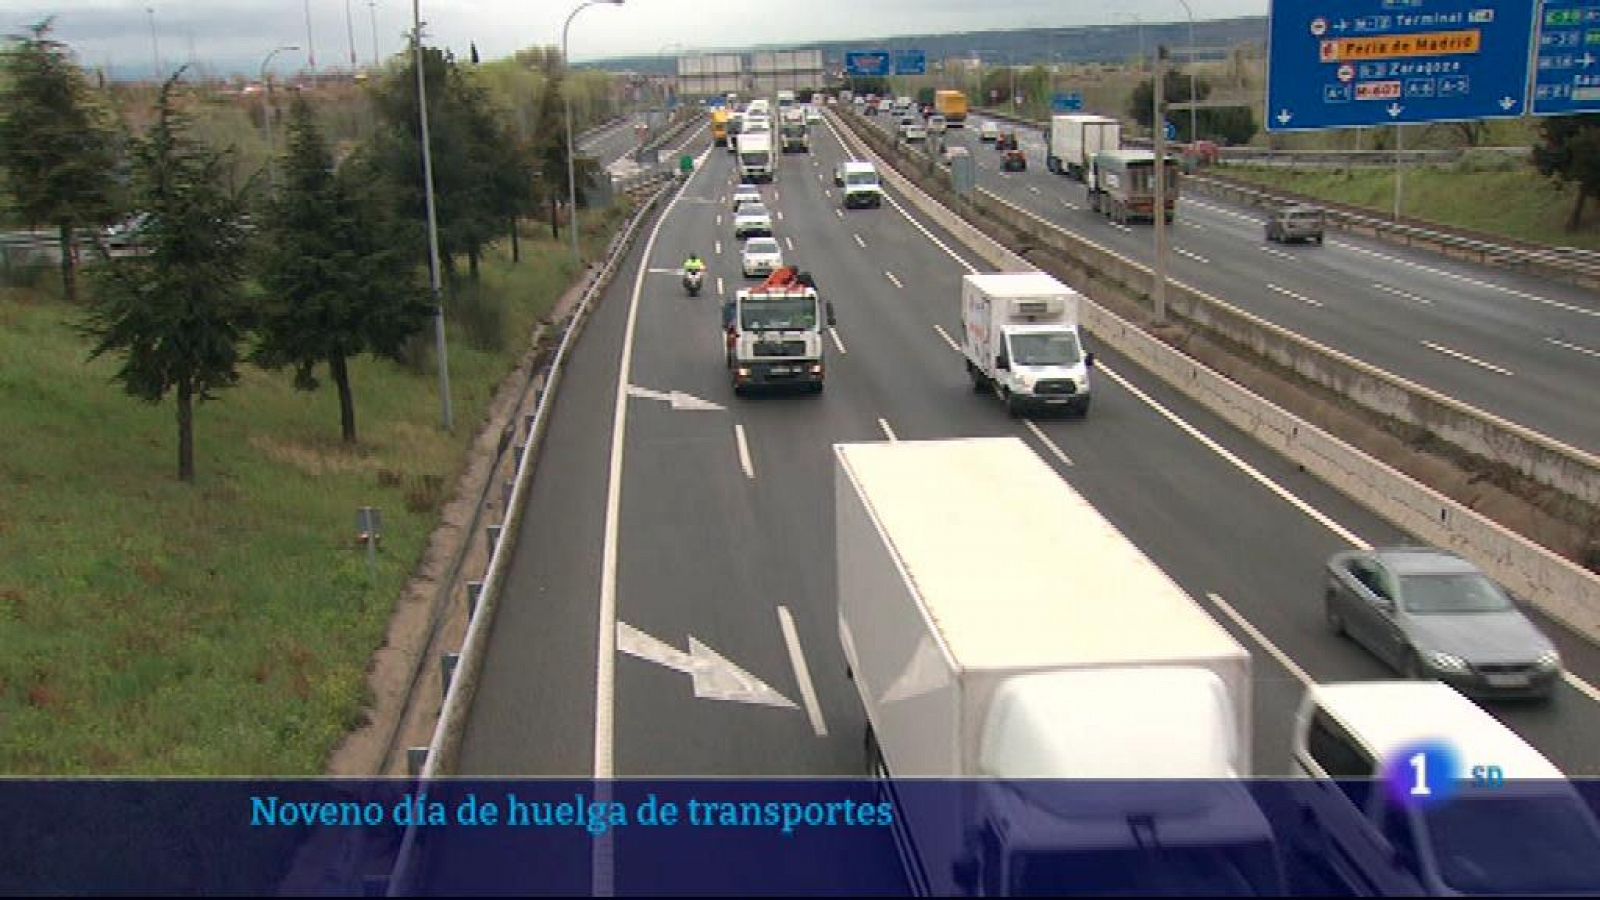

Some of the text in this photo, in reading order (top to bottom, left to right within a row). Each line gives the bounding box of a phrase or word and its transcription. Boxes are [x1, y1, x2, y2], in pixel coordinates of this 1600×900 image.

[1397, 11, 1463, 26] Terminal
[1345, 35, 1473, 55] Feria de Madrid
[1388, 61, 1460, 76] Zaragoza
